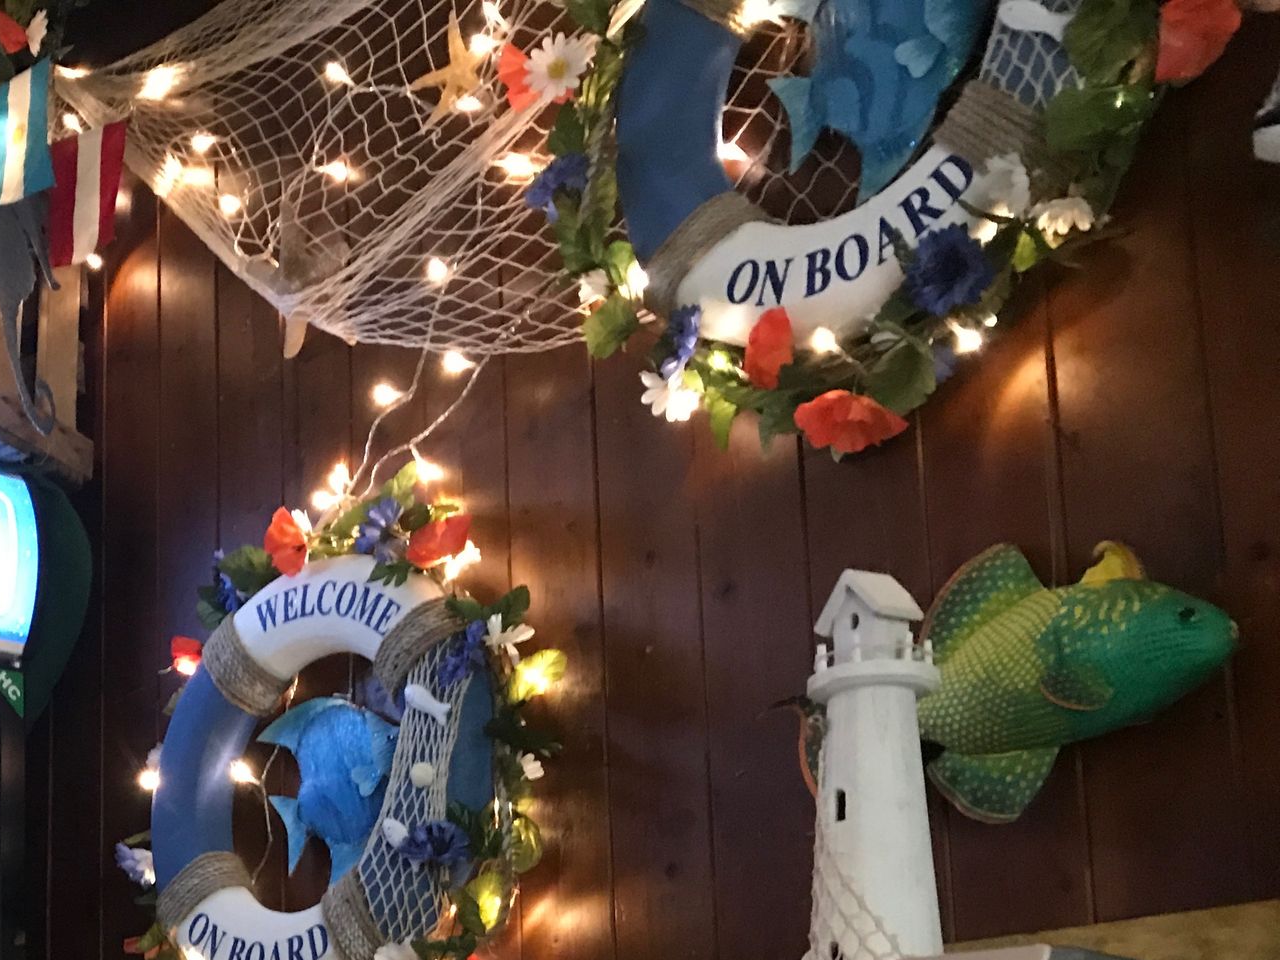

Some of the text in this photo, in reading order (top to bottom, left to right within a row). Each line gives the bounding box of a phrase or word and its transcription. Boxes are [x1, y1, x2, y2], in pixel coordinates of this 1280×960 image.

[726, 153, 974, 307] ON BOARD
[255, 580, 402, 635] WELCOME
[188, 911, 223, 960] ON
